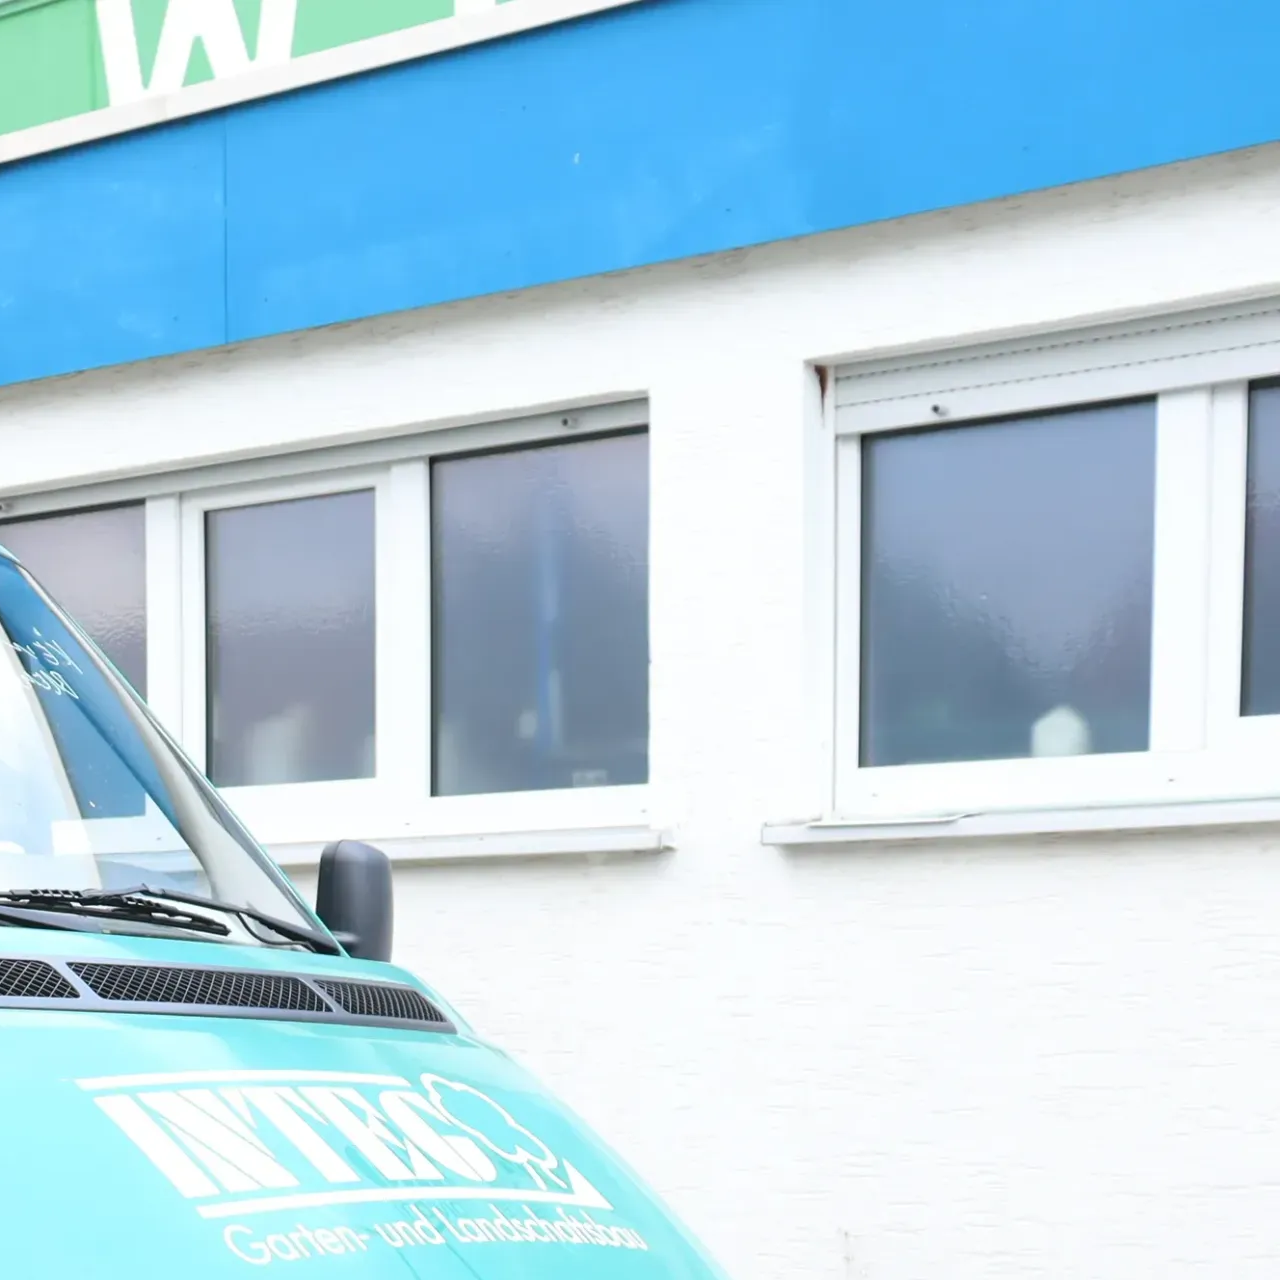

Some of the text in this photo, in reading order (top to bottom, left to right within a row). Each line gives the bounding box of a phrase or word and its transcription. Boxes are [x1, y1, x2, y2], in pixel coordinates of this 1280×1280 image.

[223, 1203, 649, 1266] Garten- und Landschaftsbau
